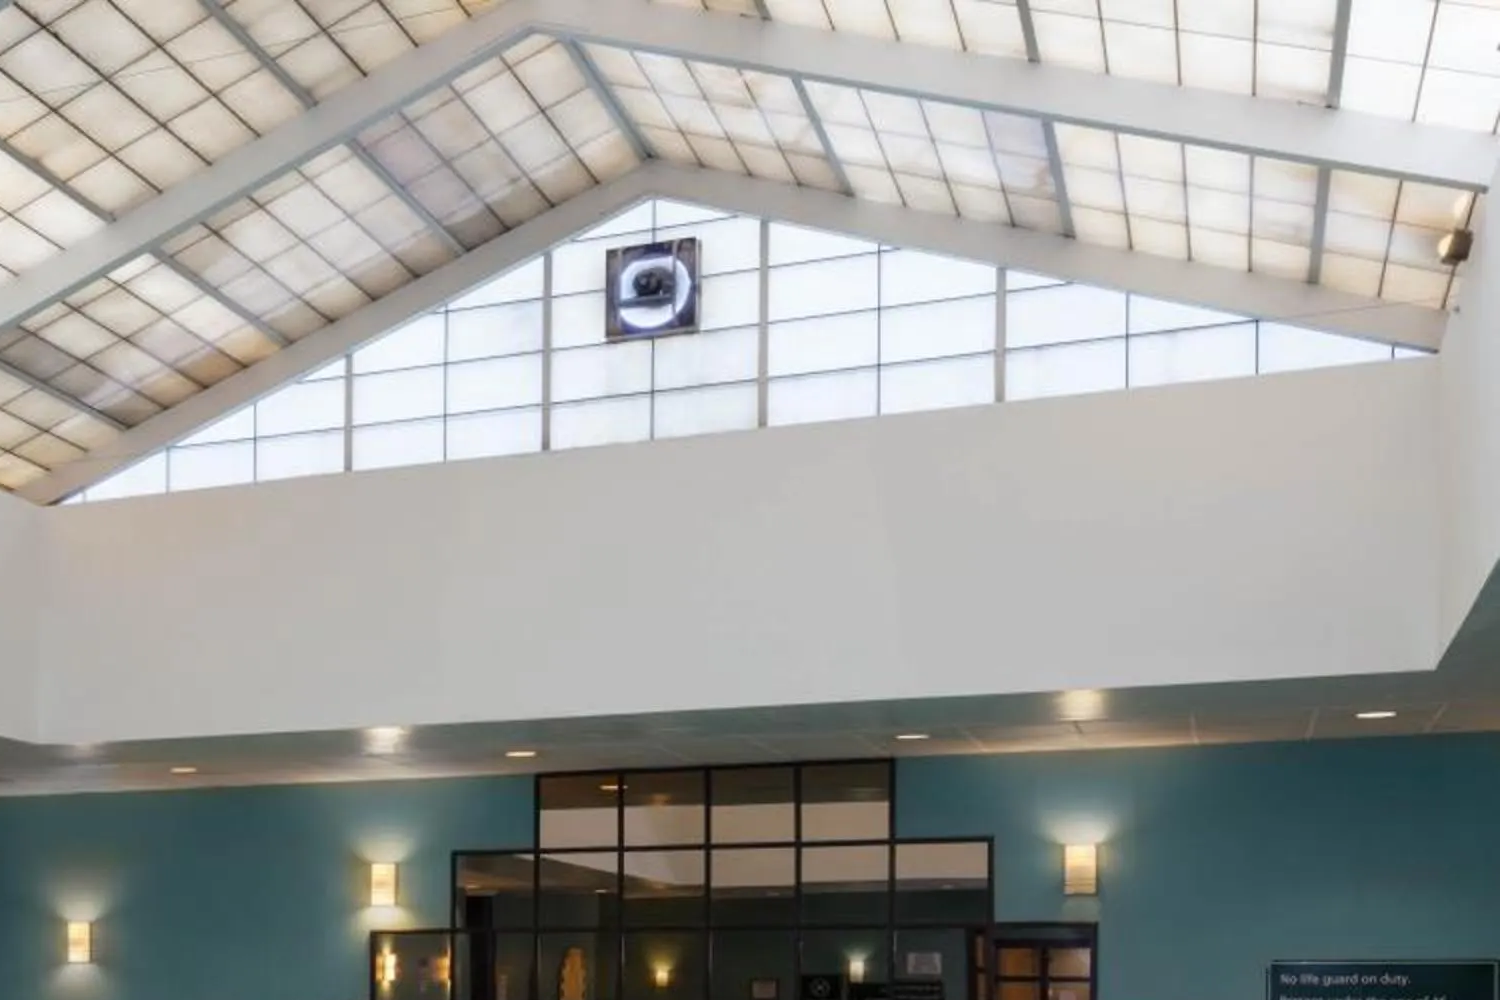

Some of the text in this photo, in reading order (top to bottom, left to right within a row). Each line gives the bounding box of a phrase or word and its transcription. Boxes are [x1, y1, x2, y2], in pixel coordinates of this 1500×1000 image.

[1280, 974, 1297, 985] No
[1322, 974, 1358, 986] guard
[1361, 974, 1377, 986] on
[1380, 974, 1412, 986] duty.
